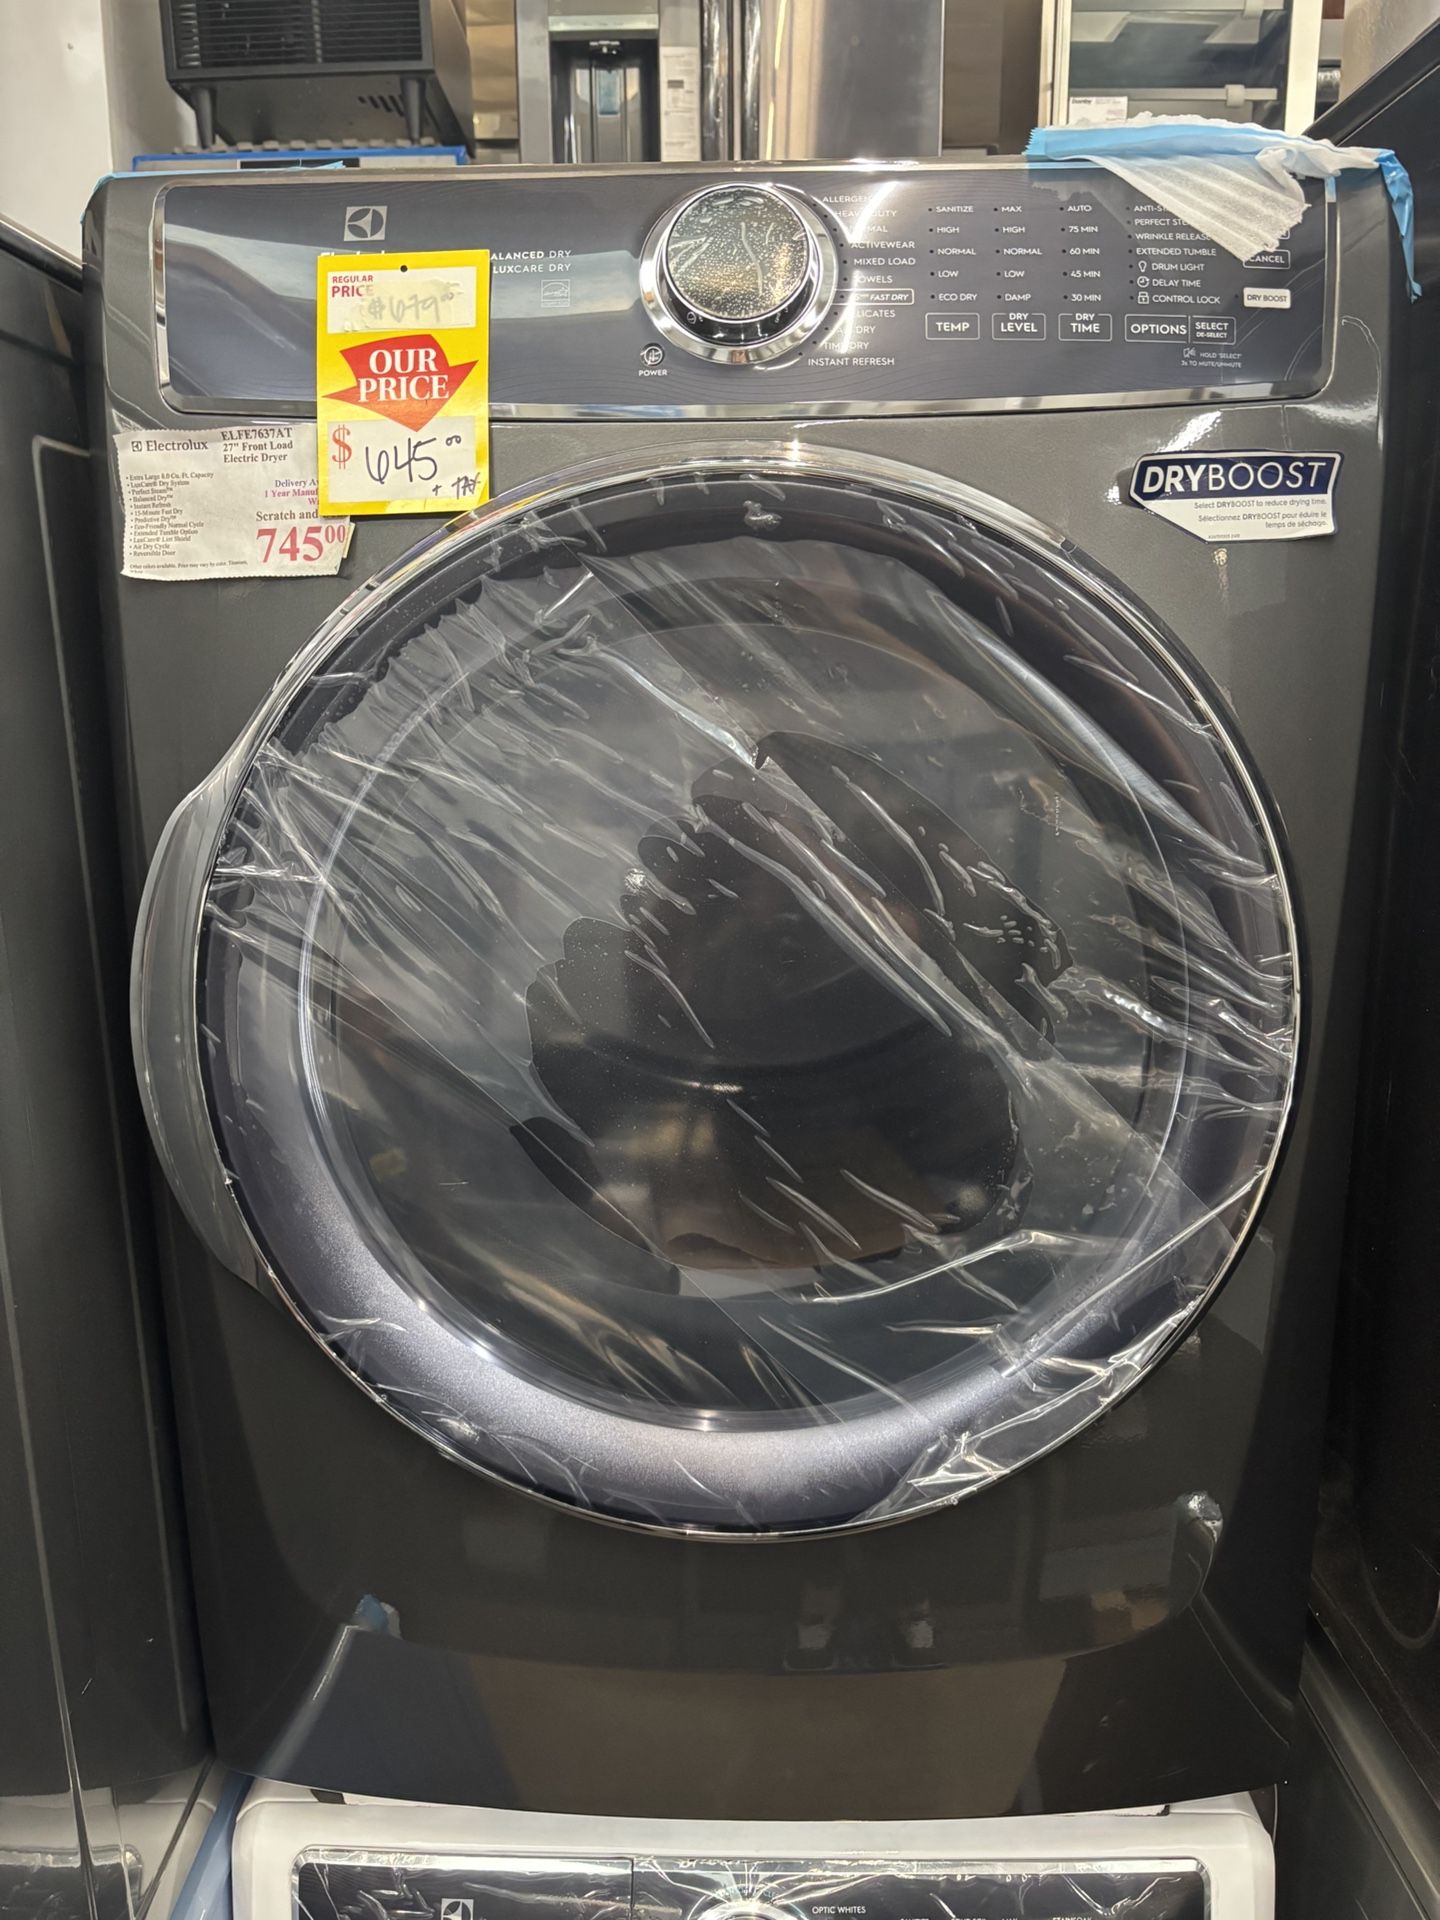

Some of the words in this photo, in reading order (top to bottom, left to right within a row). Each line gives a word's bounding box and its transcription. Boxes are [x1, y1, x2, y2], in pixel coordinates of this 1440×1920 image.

[1134, 218, 1170, 226] PERFECT
[1135, 233, 1173, 241] WRINKLE
[851, 241, 915, 249] ACTIVEWEAR
[490, 250, 544, 261] ALANCED
[549, 250, 572, 259] DRY
[1136, 248, 1182, 256] EXTENDED
[1184, 248, 1217, 256] TUMBLE
[888, 257, 916, 265] LOAD
[492, 264, 544, 274] LUXCARE
[549, 263, 572, 272] DRY
[1152, 263, 1178, 271] DRUM
[1070, 270, 1082, 278] 45
[1083, 270, 1100, 278] MIN
[332, 275, 374, 284] REGULAR
[856, 275, 893, 284] OWELS
[1152, 279, 1179, 287] DELAY
[1181, 279, 1201, 287] TIME
[332, 285, 374, 298] PRICE
[870, 293, 890, 301] FAST
[891, 293, 909, 301] DRY
[1152, 295, 1196, 303] CONTROL
[1196, 296, 1221, 304] LOCK
[1246, 294, 1262, 302] DRY
[1263, 294, 1287, 302] BOOST
[1075, 313, 1095, 321] DRY
[936, 322, 970, 332] TEMP
[1000, 322, 1038, 333] LEVEL
[1070, 323, 1100, 333] TIME
[1130, 324, 1187, 335] OPTIONS
[1195, 322, 1229, 330] SELECT
[1196, 331, 1227, 339] DE-SELECT
[369, 348, 438, 374] OUR
[808, 358, 849, 366] INSTANT
[852, 358, 895, 366] REFRESH
[638, 369, 668, 377] POWER
[358, 375, 449, 402] PRICE
[221, 428, 292, 441] ELFE7637AT
[146, 439, 208, 452] Electrolux
[223, 443, 239, 452] 27"
[242, 441, 267, 452] Front
[270, 440, 293, 450] Load
[223, 453, 258, 463] Electric
[261, 453, 287, 464] Dryer
[1143, 461, 1326, 494] DRYBOOST
[275, 479, 307, 488] Delivery
[1216, 500, 1255, 508] DRYBOOST
[1289, 499, 1310, 507] drying
[256, 510, 296, 521] Scratch
[298, 509, 318, 519] and
[1242, 512, 1281, 520] DRYBOOST
[812, 1906, 835, 1914] OPTIC
[837, 1906, 866, 1914] WHITES
